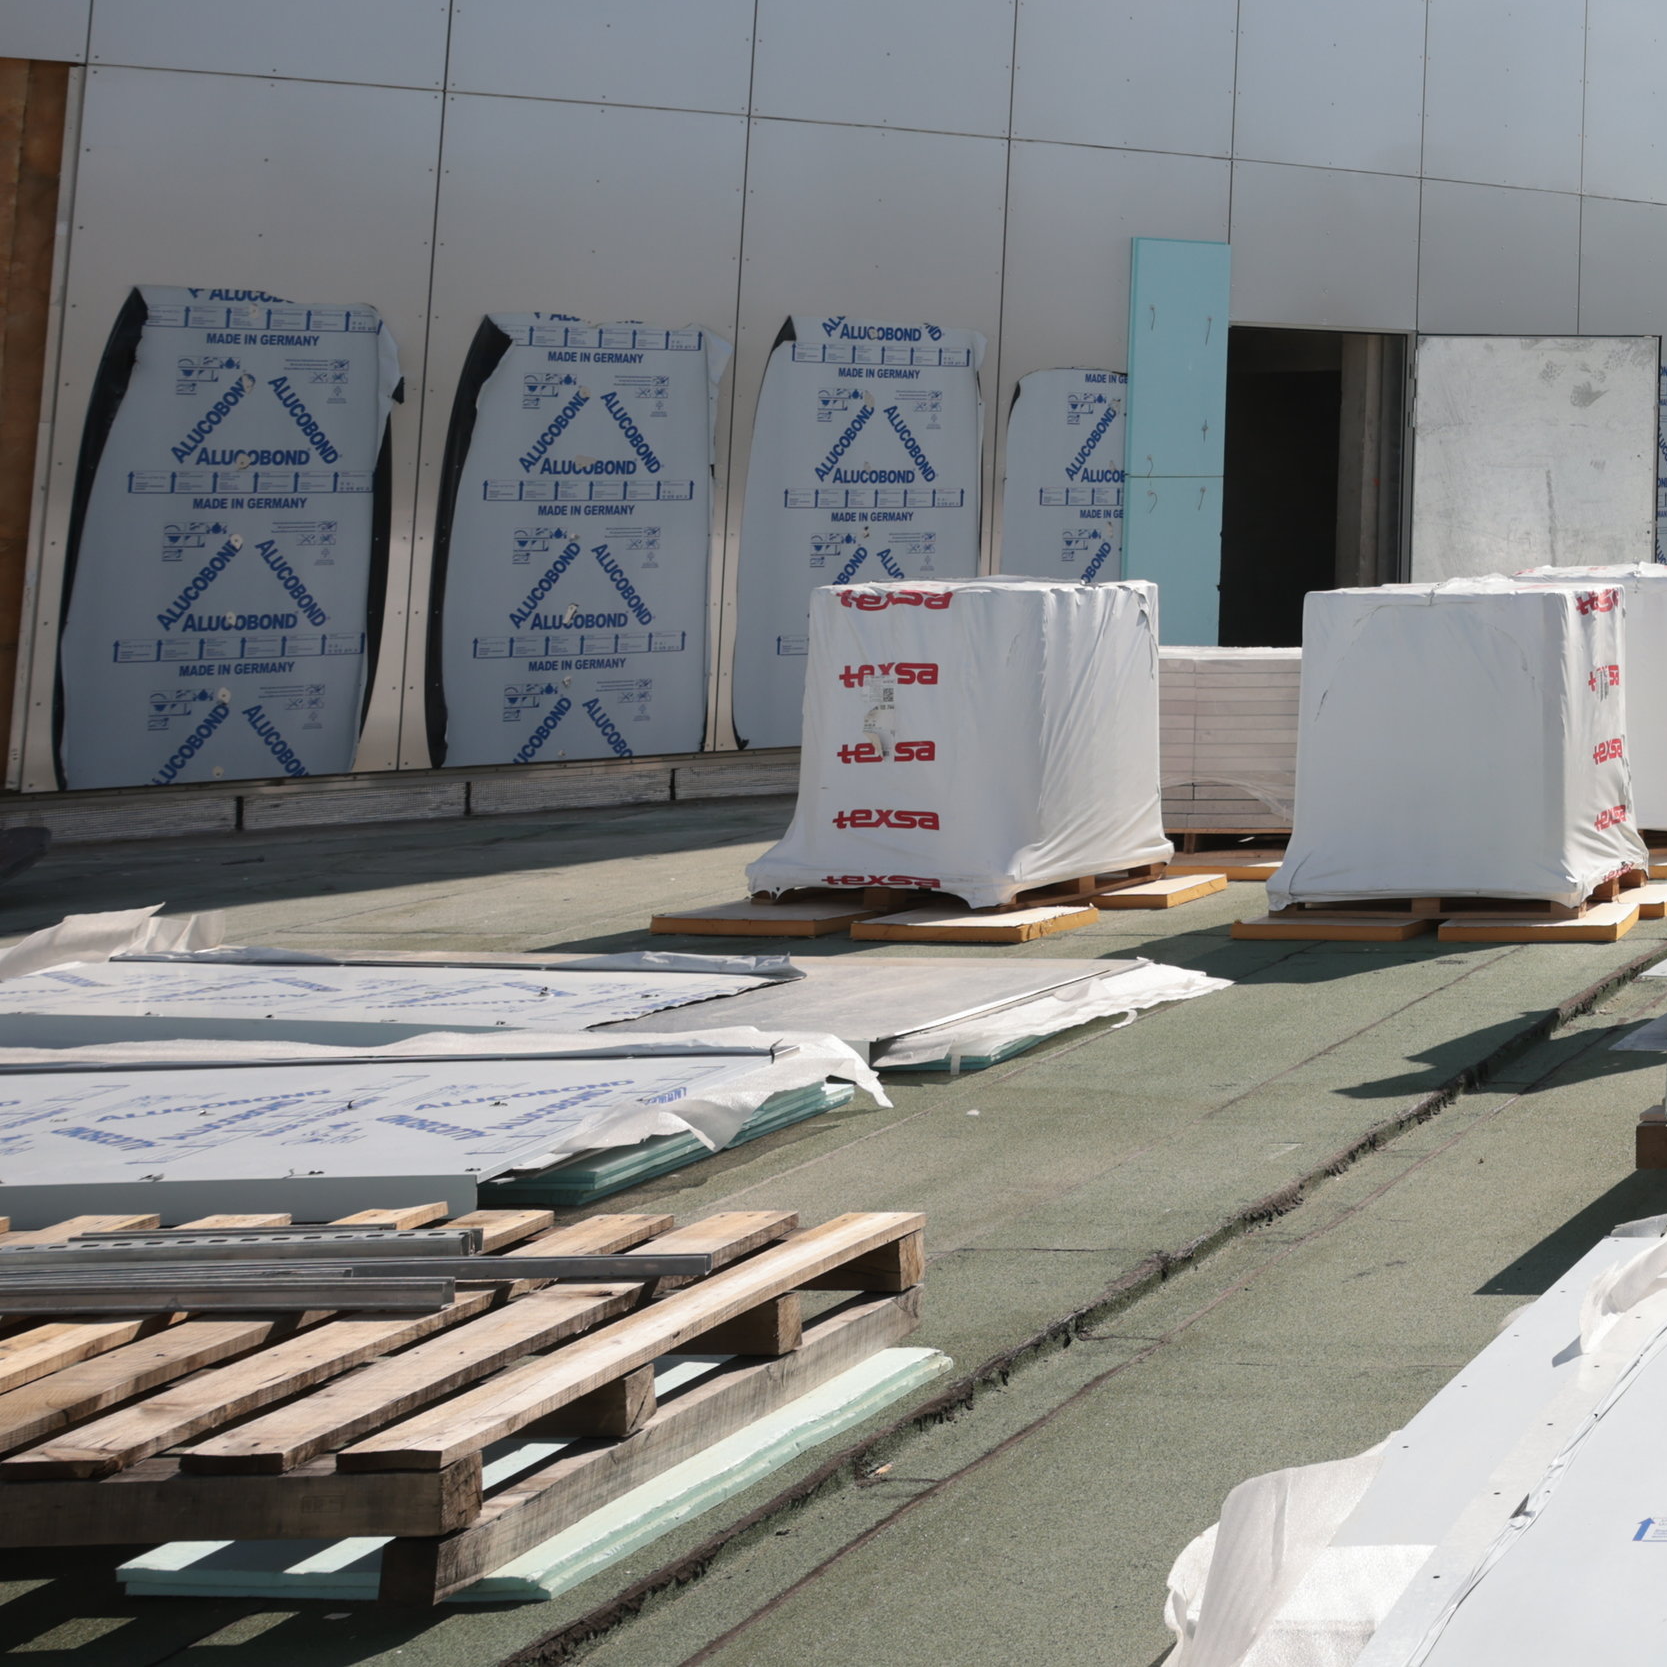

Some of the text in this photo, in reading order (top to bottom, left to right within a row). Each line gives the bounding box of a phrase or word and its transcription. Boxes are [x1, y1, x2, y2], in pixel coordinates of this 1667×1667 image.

[206, 333, 319, 346] MADE IN GERMANY
[547, 351, 643, 364] MADE IN GERMANY
[838, 367, 920, 379] MADE IN GERMANY
[1085, 374, 1106, 383] MADE
[1109, 374, 1117, 383] IN
[268, 375, 338, 465] ALUCOBOND
[601, 391, 661, 474] ALUCOBOND
[883, 405, 936, 483] ALUCOBOND
[832, 467, 915, 484] ALUCOBOND
[193, 498, 307, 509] MADE IN GERMANY
[538, 505, 635, 516] MADE IN GERMANY
[831, 512, 914, 522] MADE IN GERMANY
[1080, 509, 1101, 518] MADE
[1103, 509, 1112, 518] IN
[255, 538, 327, 628] ALUCOBOND
[509, 541, 581, 629] ALUCOBOND
[591, 543, 653, 626] ALUCOBOND
[179, 662, 295, 677] MADE IN GERMANY
[528, 658, 627, 672] MADE IN GERMANY
[837, 741, 936, 764] tesa
[1593, 738, 1622, 765] texsa
[832, 809, 940, 831] texsa
[821, 875, 941, 889] texsa
[414, 1079, 635, 1111] ALUCOBOND
[96, 1089, 330, 1122] ALUCOBOND
